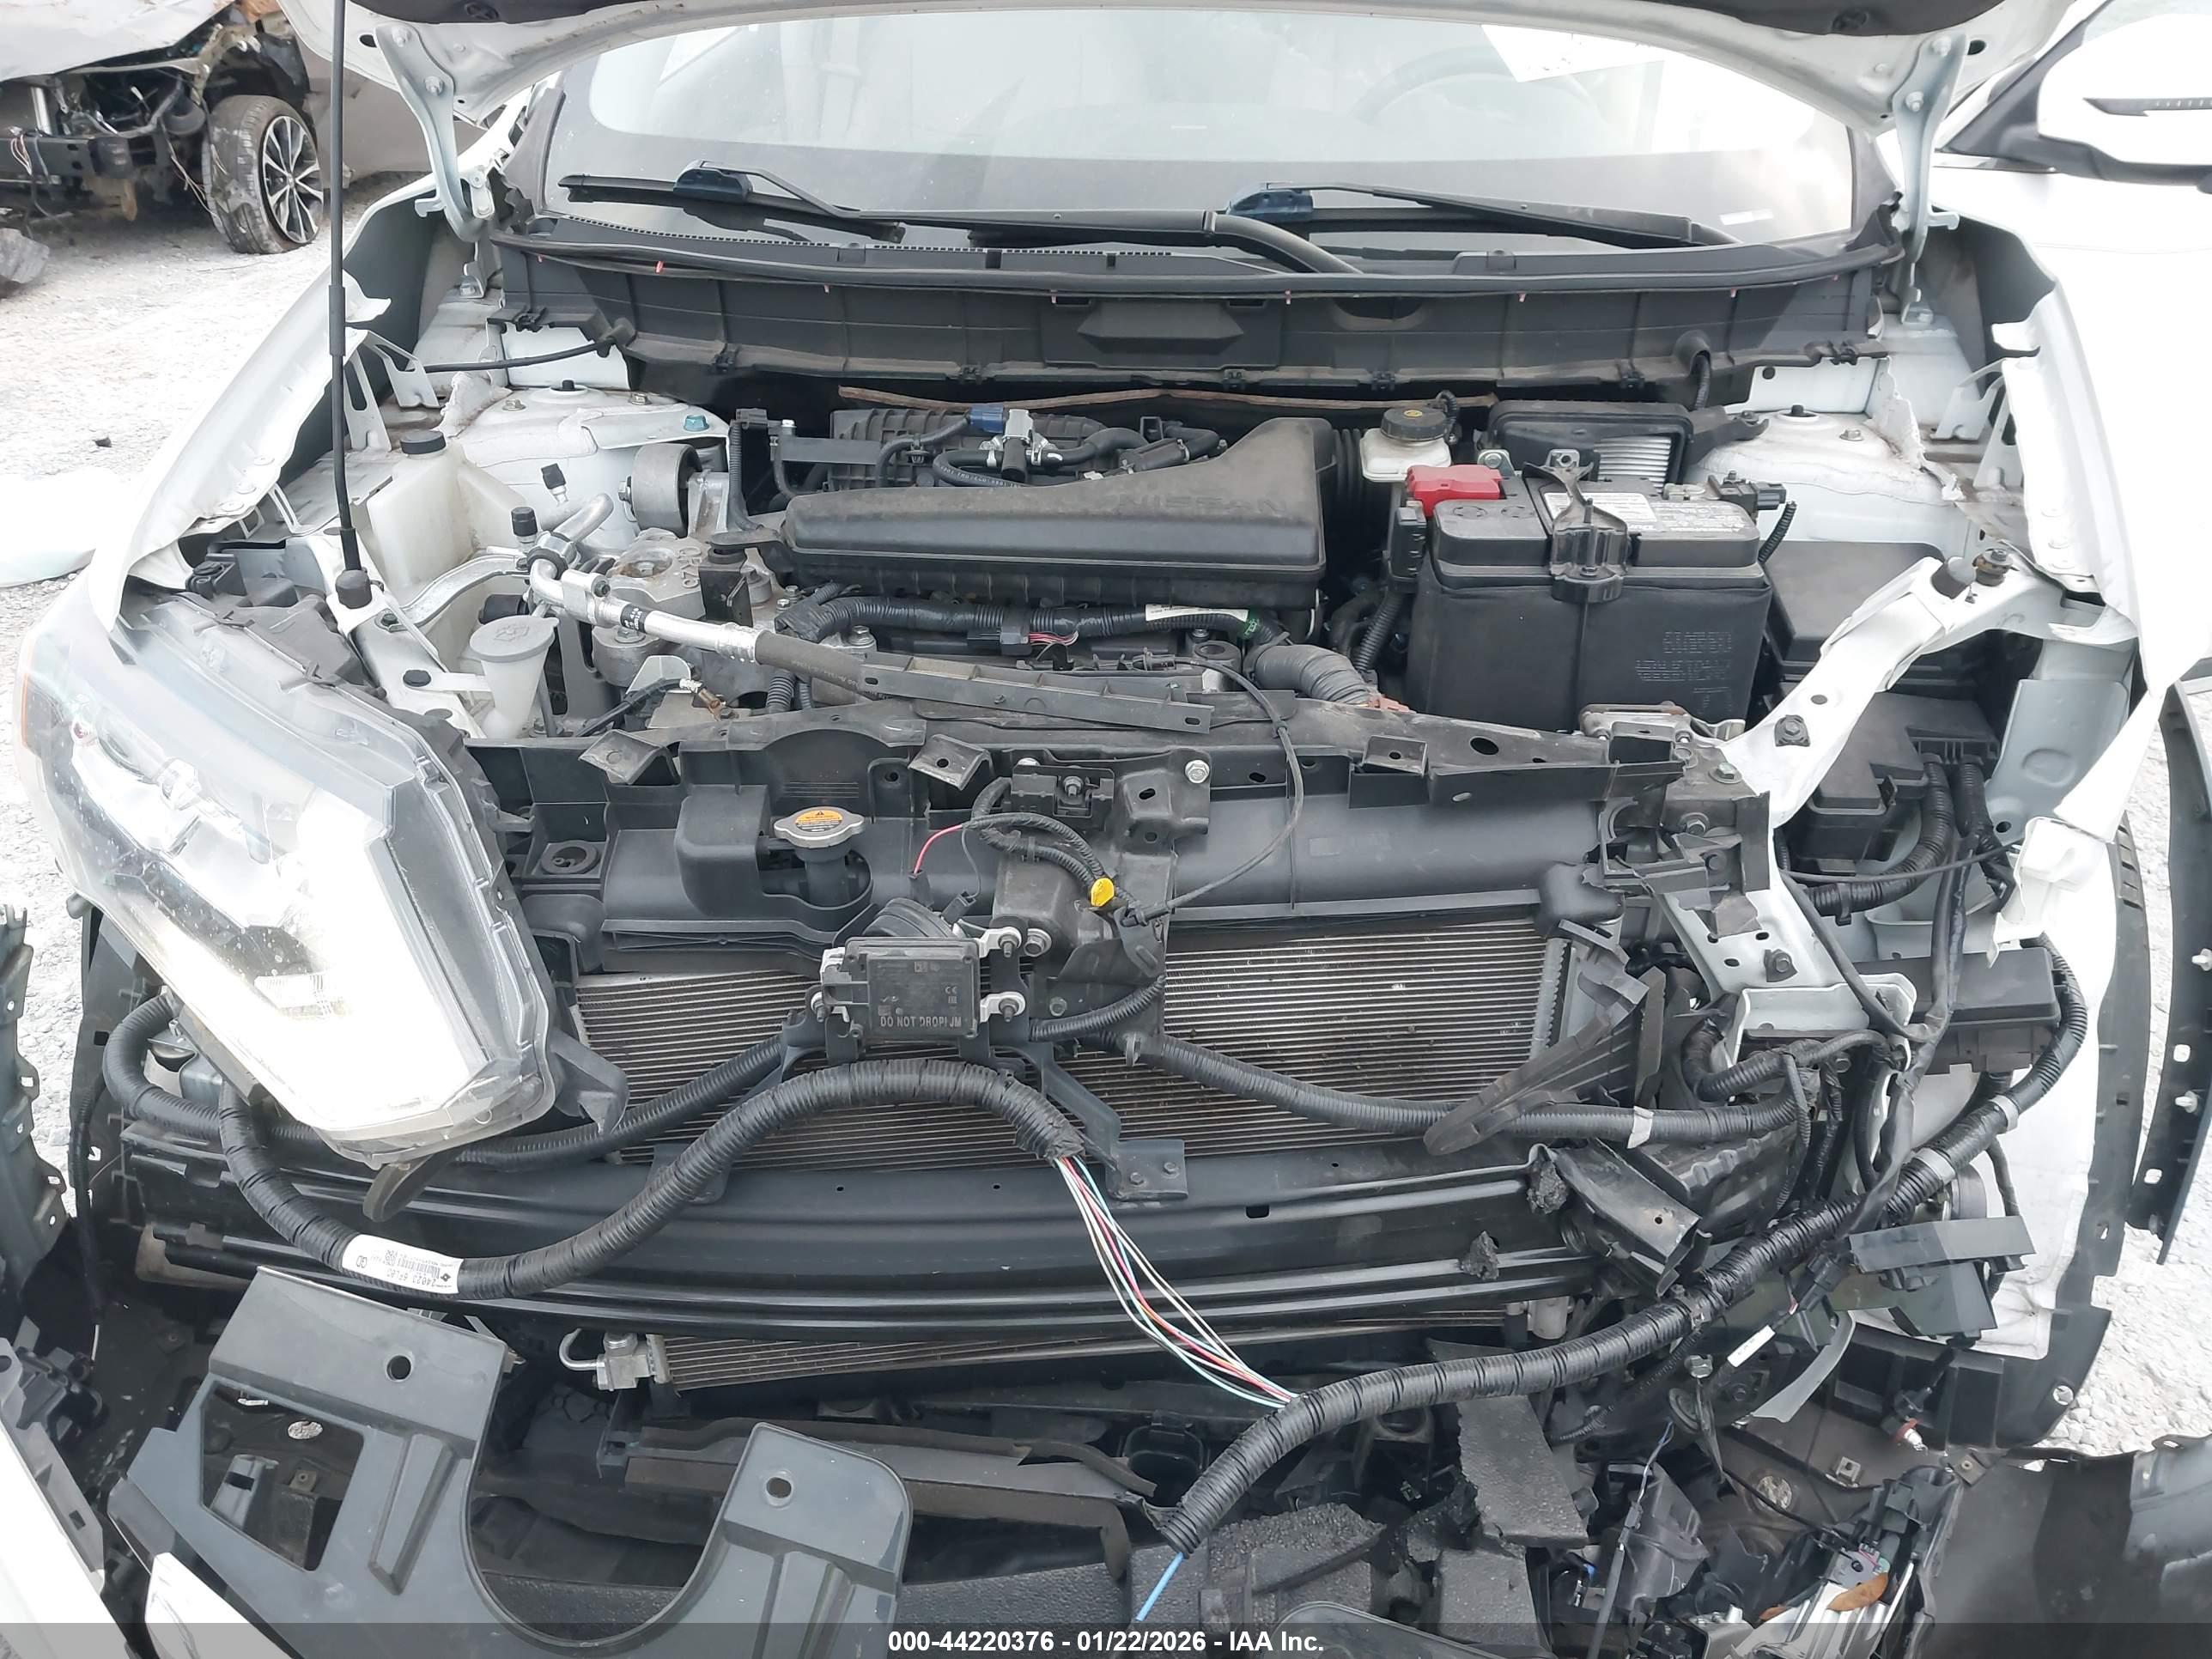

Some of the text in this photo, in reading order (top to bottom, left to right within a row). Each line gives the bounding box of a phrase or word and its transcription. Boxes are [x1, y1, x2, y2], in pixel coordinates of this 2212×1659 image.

[1117, 494, 1287, 514] NISSAN
[880, 1016, 894, 1028] DO
[896, 1016, 916, 1028] NOT
